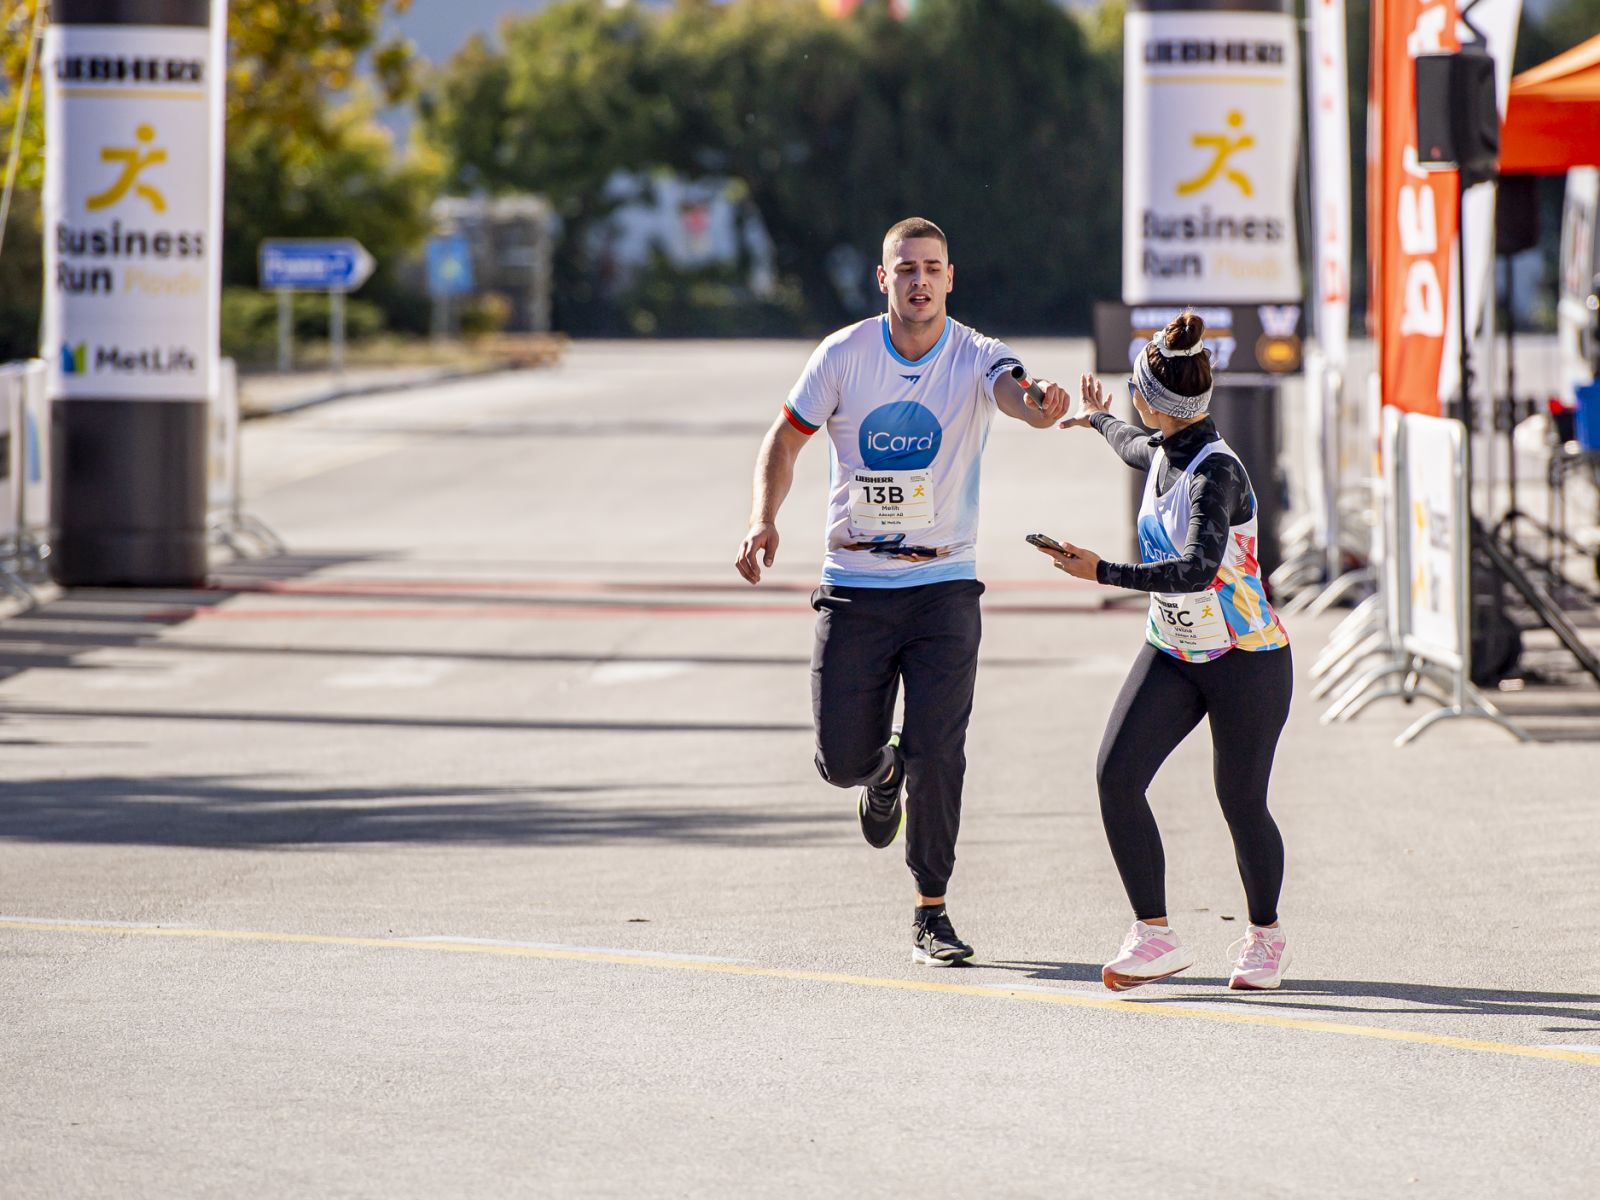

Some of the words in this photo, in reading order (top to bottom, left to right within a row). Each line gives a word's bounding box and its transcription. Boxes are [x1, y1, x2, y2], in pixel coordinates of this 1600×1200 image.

[867, 430, 935, 452] iCard
[855, 474, 894, 484] LIEBHERR
[862, 485, 905, 505] 13B
[1158, 605, 1194, 627] 13C
